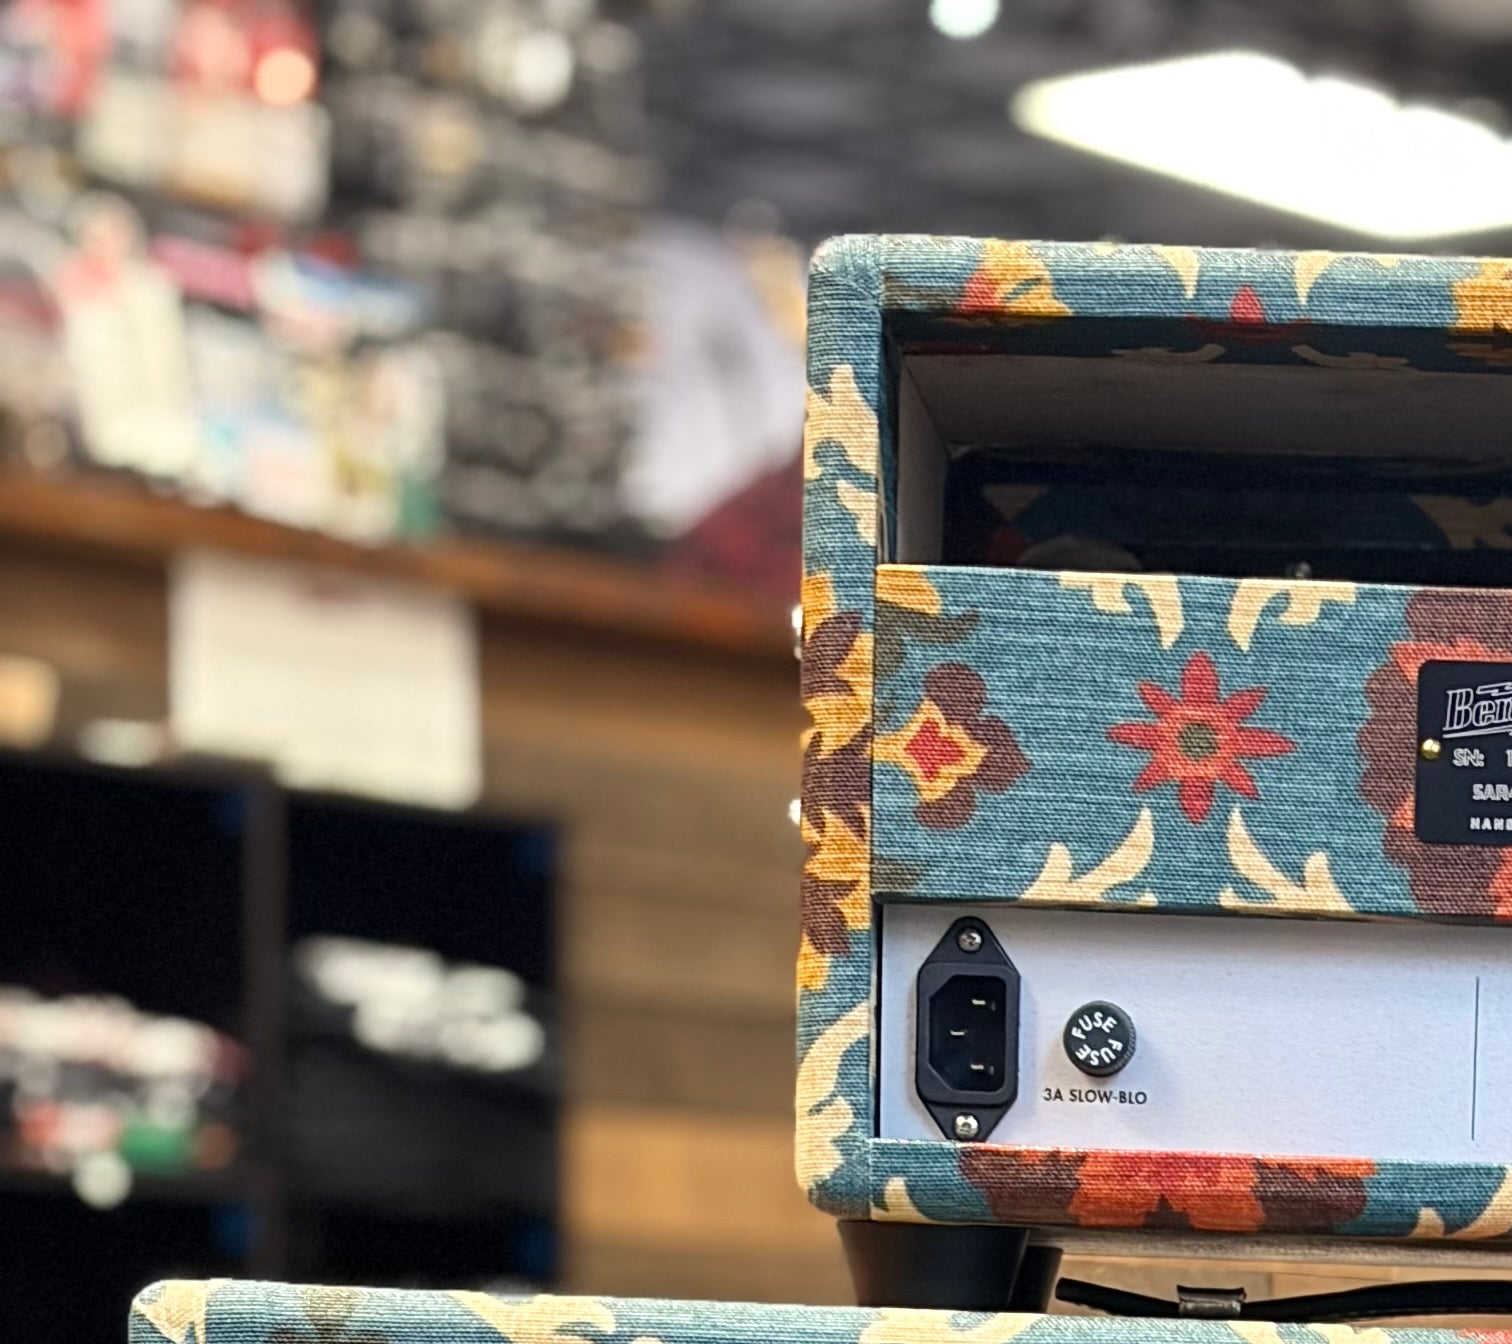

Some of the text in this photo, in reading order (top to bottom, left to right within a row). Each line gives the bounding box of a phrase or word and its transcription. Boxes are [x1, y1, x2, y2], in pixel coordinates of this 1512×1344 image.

[1453, 748, 1485, 767] SN:
[1071, 1012, 1117, 1040] FUSE
[1075, 1039, 1123, 1066] FUSE
[1043, 1087, 1148, 1105] 3A SLOW-BLO
